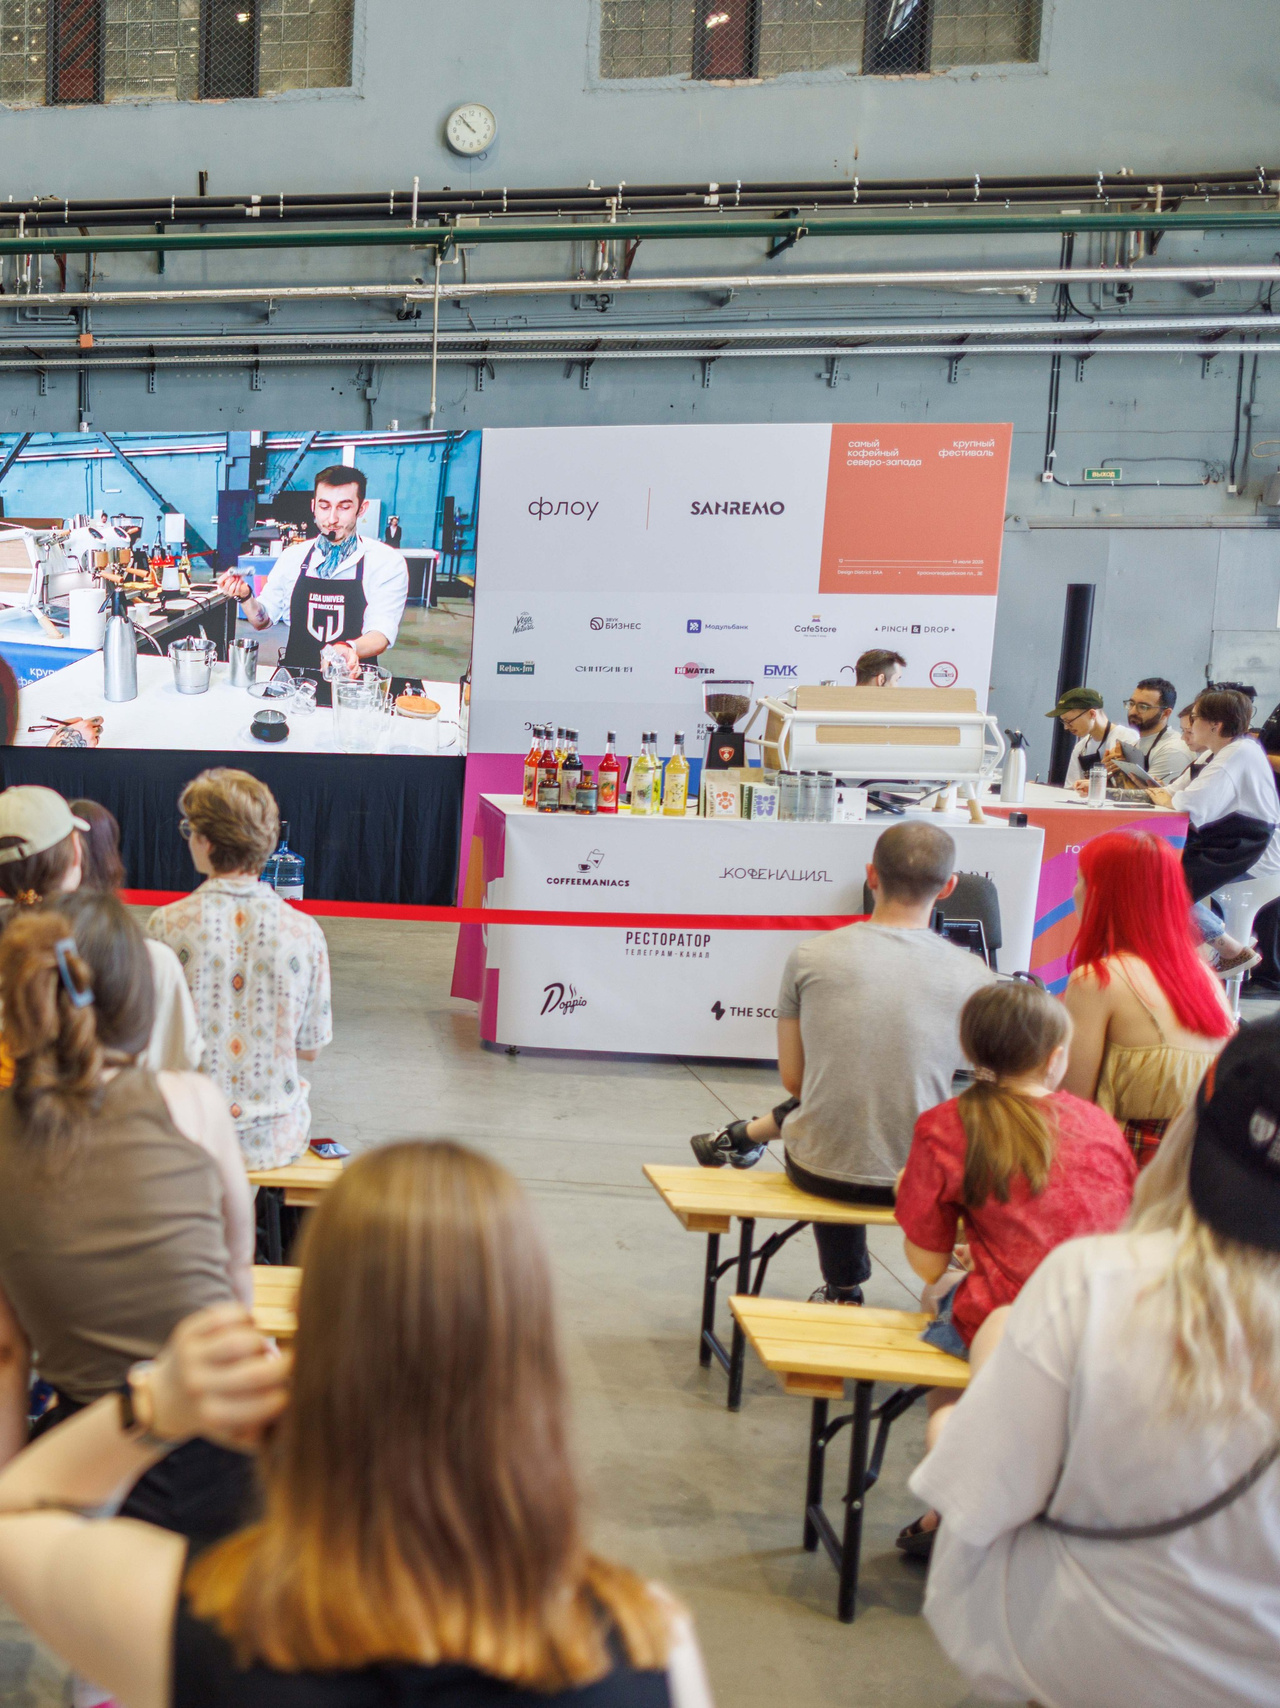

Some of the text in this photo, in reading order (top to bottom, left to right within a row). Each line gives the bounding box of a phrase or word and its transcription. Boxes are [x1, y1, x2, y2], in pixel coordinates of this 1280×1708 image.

[848, 439, 995, 448] самый крупный
[847, 448, 994, 458] кофейный фестиваль
[846, 459, 922, 468] северо-запада
[527, 496, 600, 521] флоу
[690, 501, 785, 516] SANREMO
[605, 622, 642, 630] БИЗНЕС
[794, 624, 837, 633] CafeStore
[881, 625, 908, 633] PINCH
[763, 664, 798, 676] БМК
[546, 876, 630, 887] COFFEEMANIACS
[625, 931, 712, 947] РЕСТОРАТОР
[625, 948, 711, 959] ТЕЛЕГРАМ-КАНАЛ
[540, 982, 587, 1016] Doppio
[729, 1006, 754, 1017] THE
